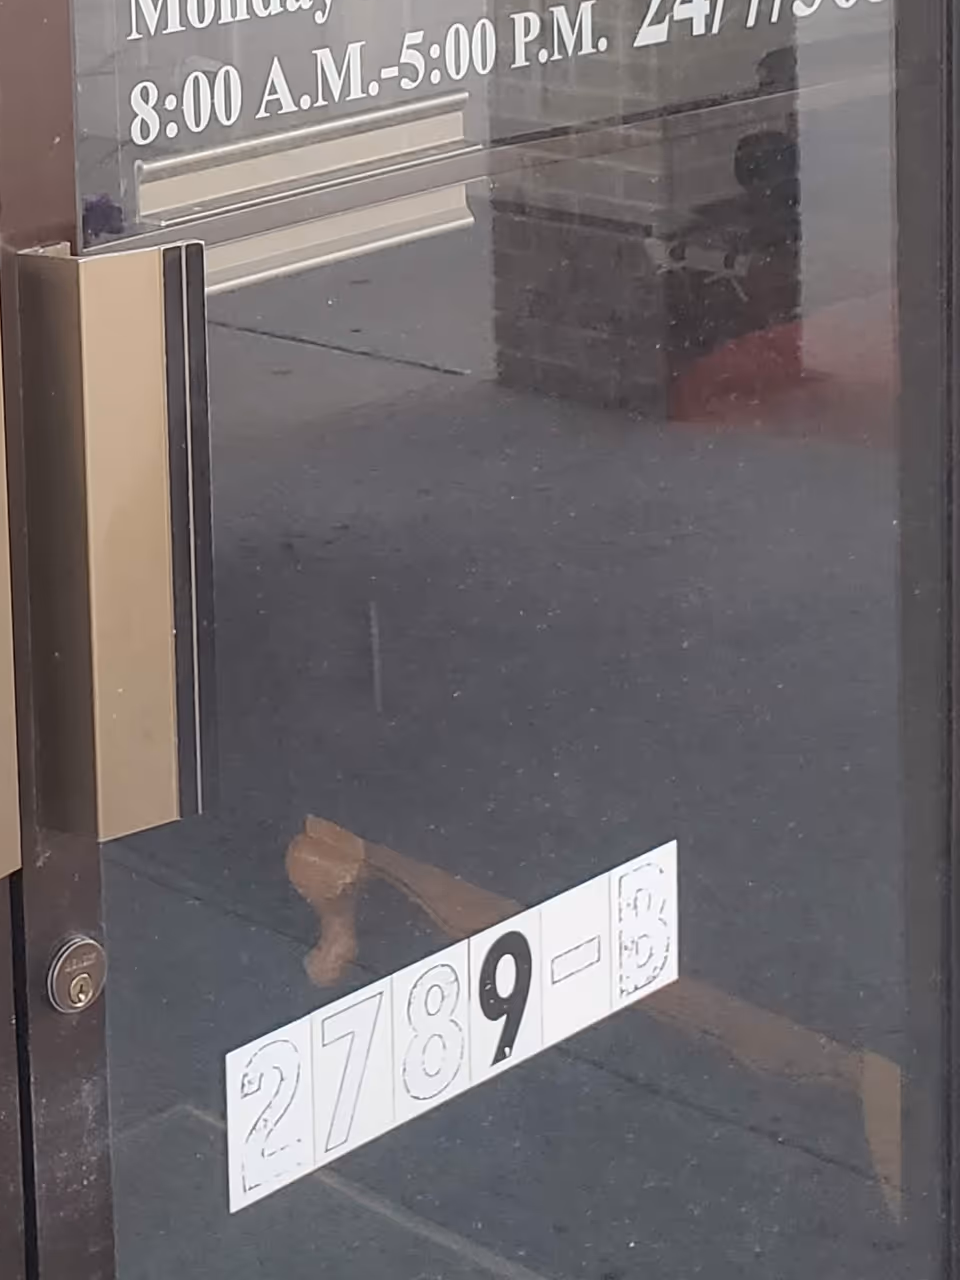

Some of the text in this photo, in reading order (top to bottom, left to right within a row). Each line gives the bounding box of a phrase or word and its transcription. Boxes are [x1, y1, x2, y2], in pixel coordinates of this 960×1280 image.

[129, 0, 608, 146] 8:00 A.M.-5:00 P.M.
